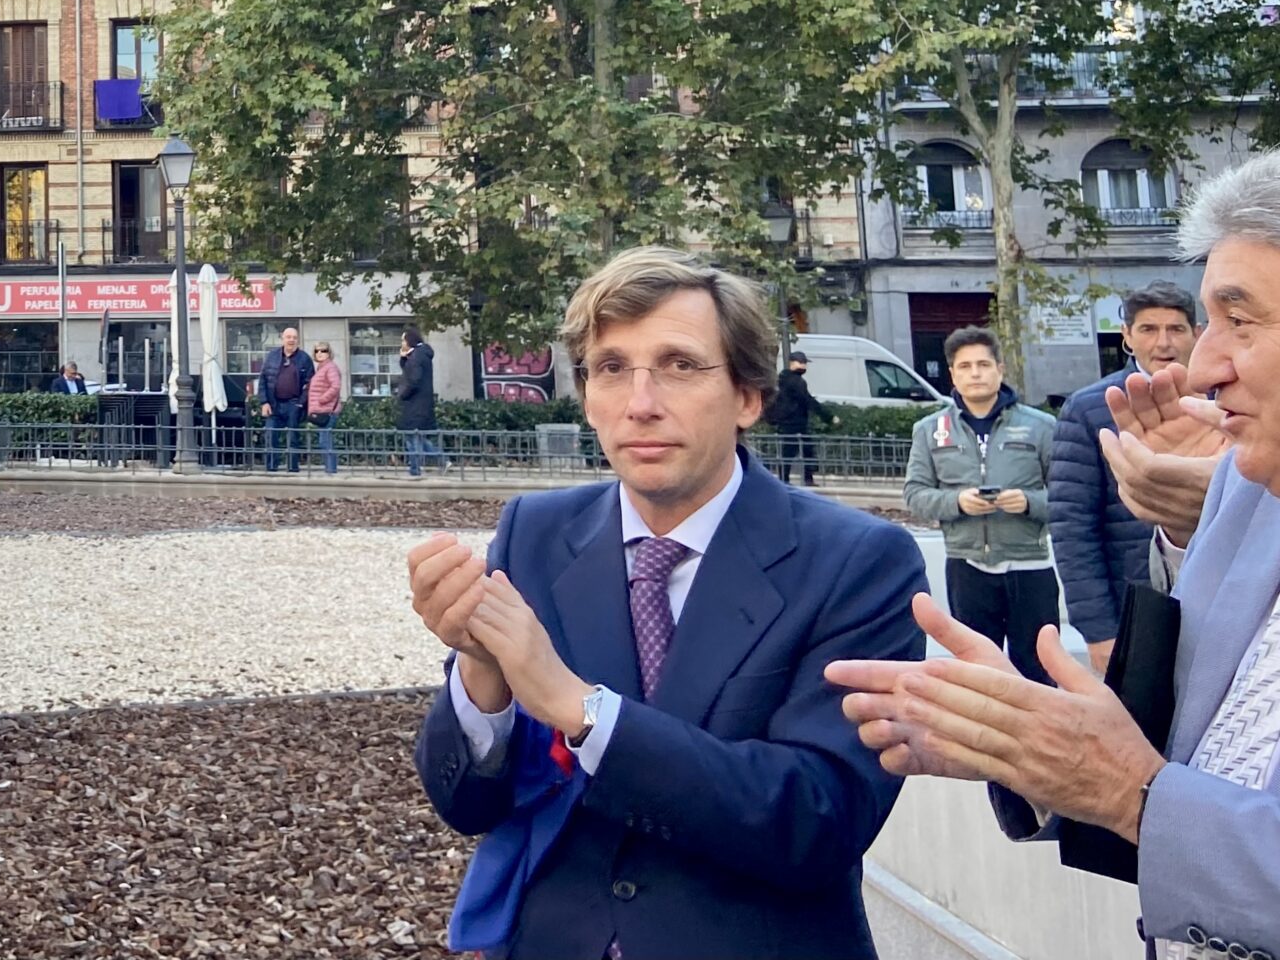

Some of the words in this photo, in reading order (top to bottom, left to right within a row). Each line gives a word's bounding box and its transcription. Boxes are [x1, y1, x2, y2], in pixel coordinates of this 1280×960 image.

[20, 286, 82, 296] PERFUMRIA
[96, 284, 138, 295] MENAJE
[218, 283, 265, 294] JUGTE
[24, 300, 78, 310] PAPELEIA
[87, 299, 148, 309] FERRETERIA
[221, 298, 262, 308] REGALO
